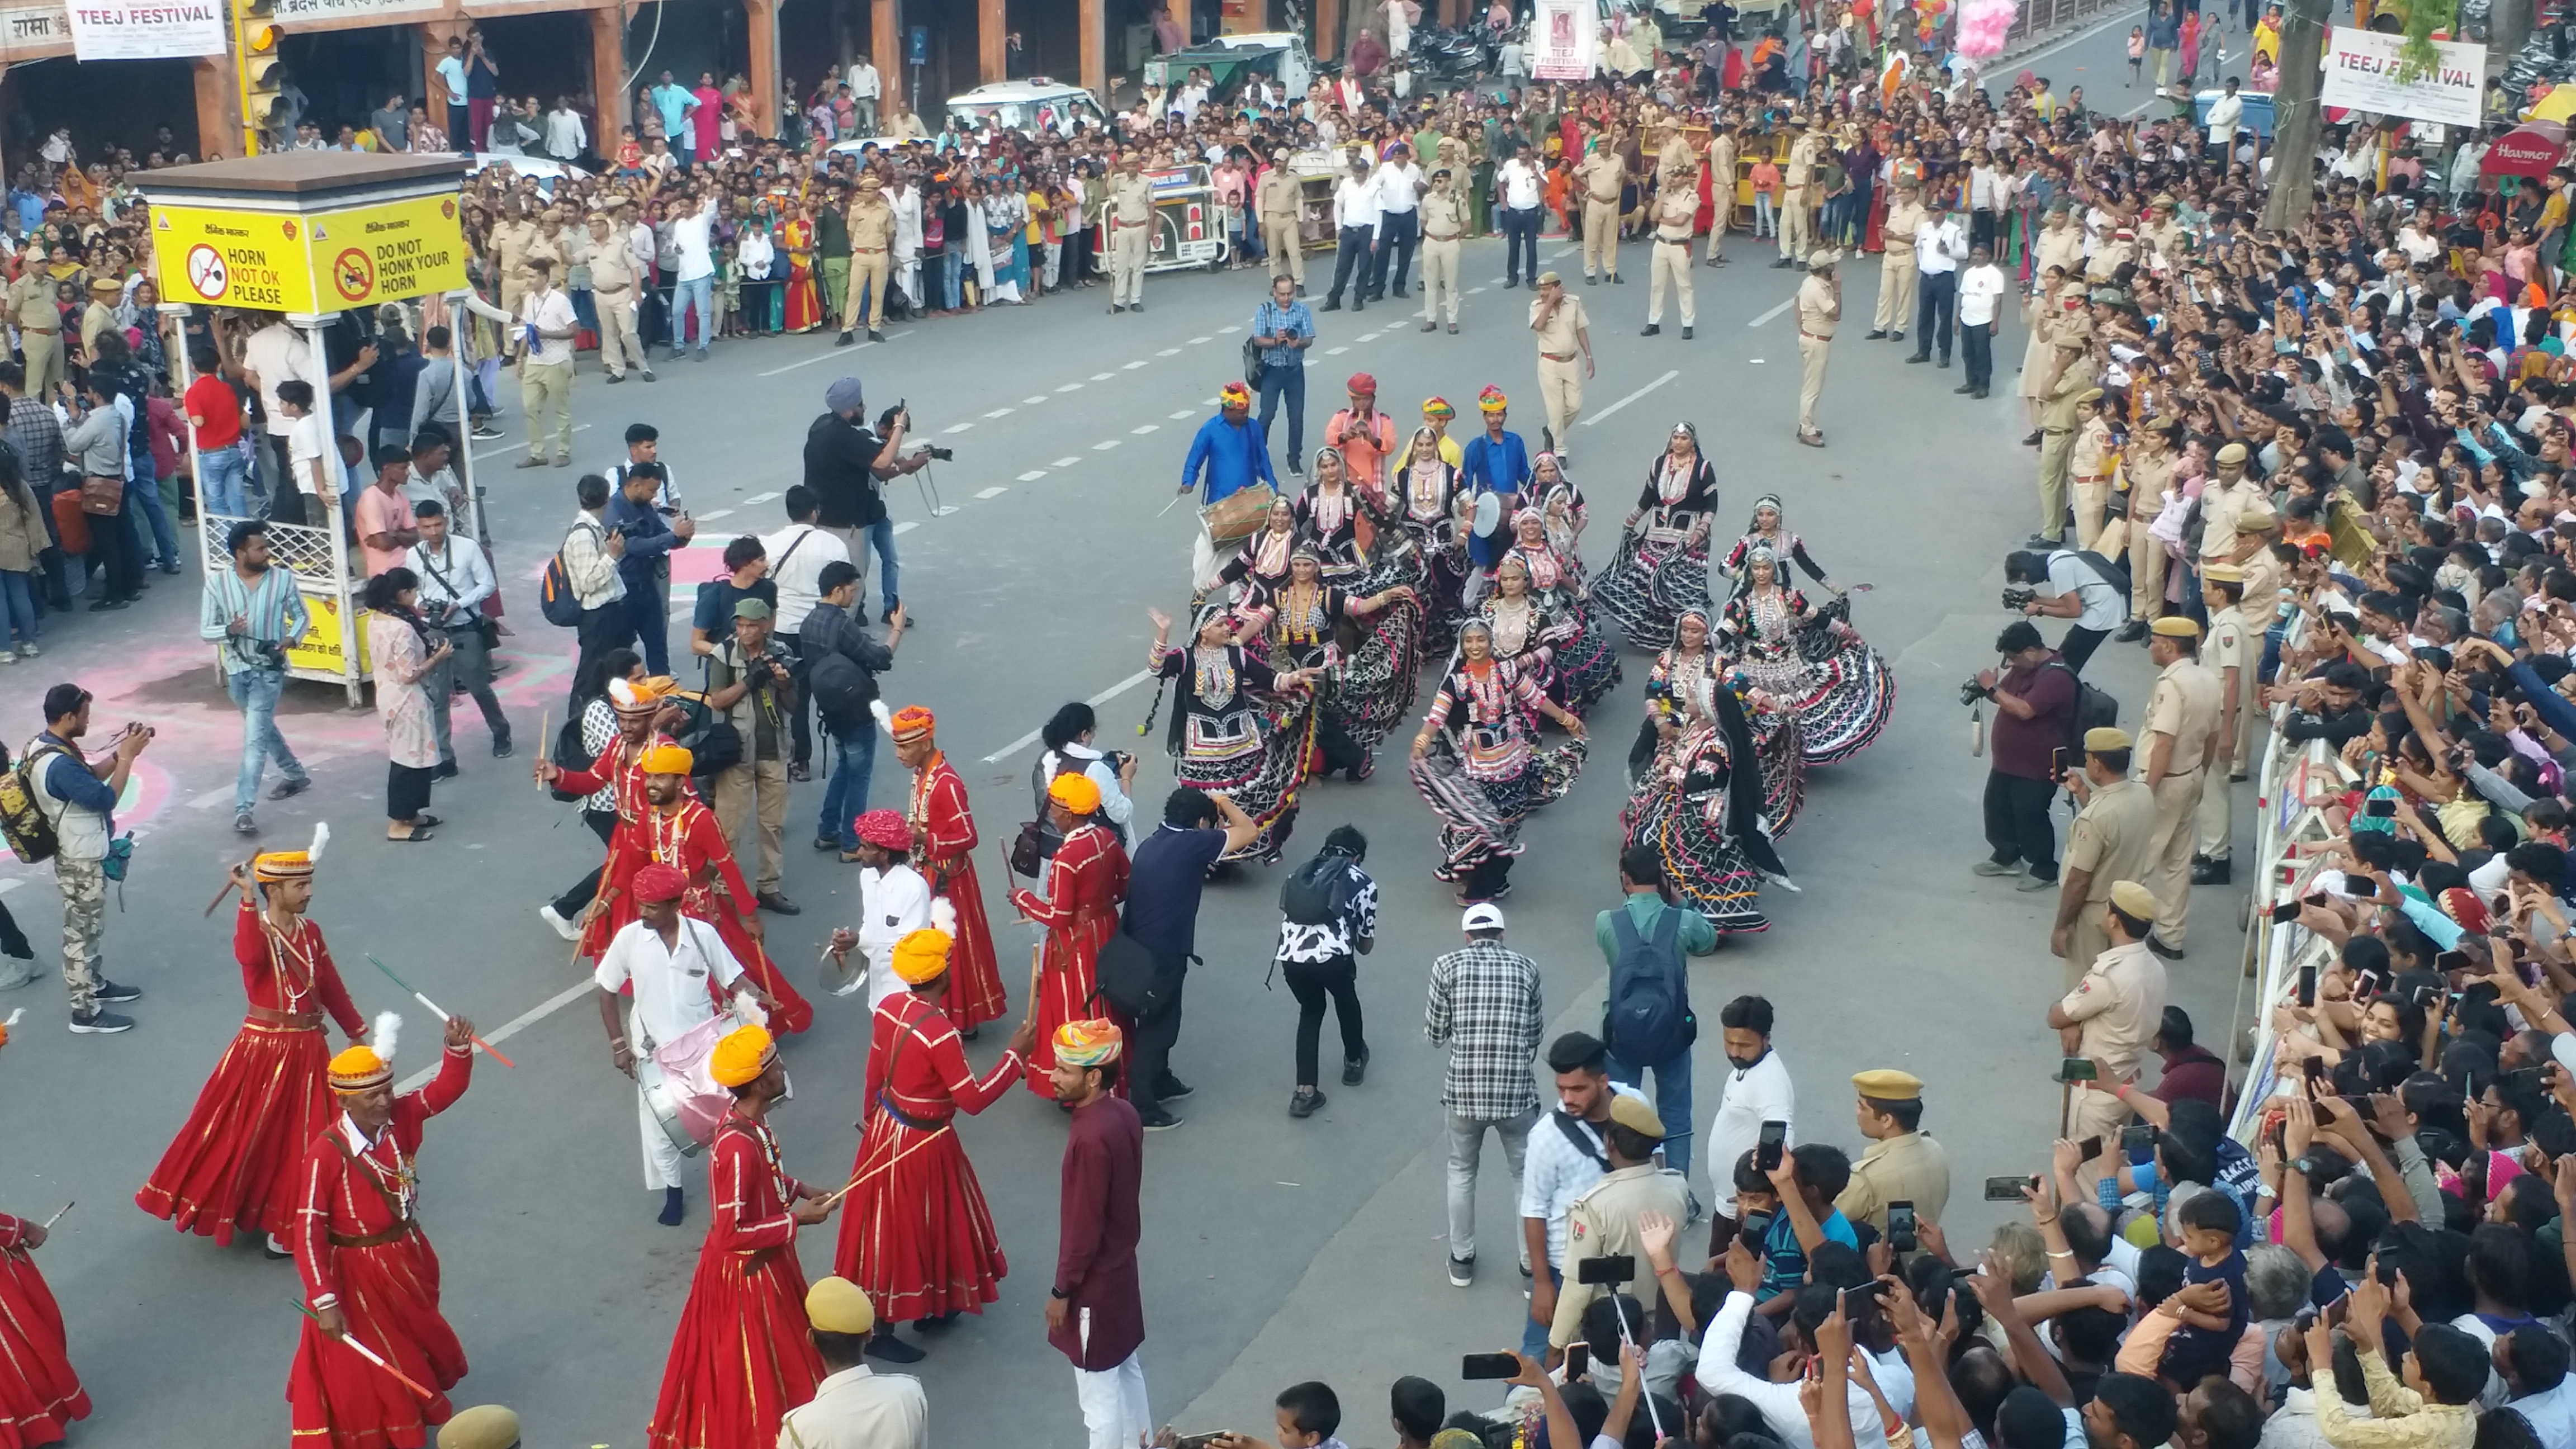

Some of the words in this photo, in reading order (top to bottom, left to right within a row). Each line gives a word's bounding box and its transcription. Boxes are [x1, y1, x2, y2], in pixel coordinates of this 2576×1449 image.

[77, 10, 124, 25] TEEJ
[130, 6, 214, 25] FESTIVAL
[1541, 57, 1583, 65] FESTIVAL
[1552, 49, 1574, 58] TEEJ
[2338, 51, 2383, 74] TEEJ
[2497, 143, 2552, 160] Havmor
[228, 248, 267, 266] HORN
[376, 244, 394, 261] DO
[397, 238, 422, 255] NOT
[378, 258, 415, 277] HONK
[416, 250, 450, 270] YOUR
[230, 267, 258, 283] NOT
[261, 271, 281, 286] OK
[381, 274, 416, 295] HORN
[233, 285, 282, 305] PLEASE
